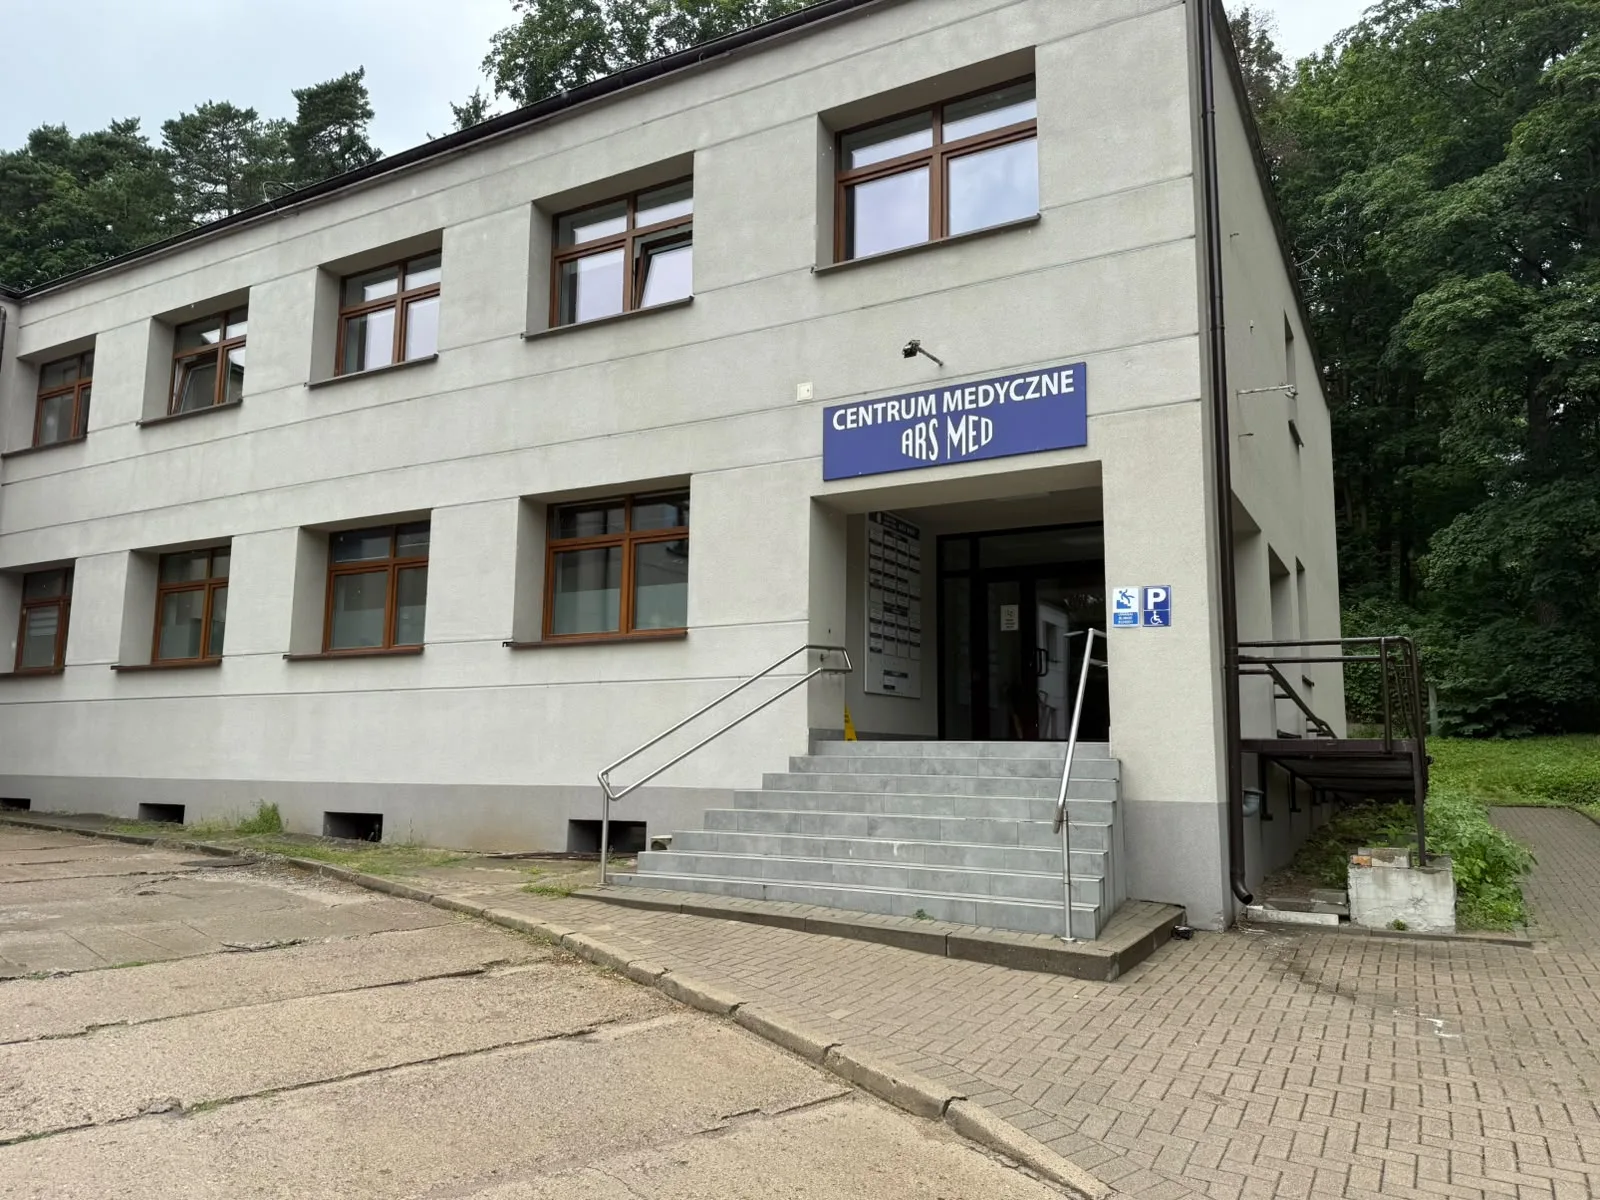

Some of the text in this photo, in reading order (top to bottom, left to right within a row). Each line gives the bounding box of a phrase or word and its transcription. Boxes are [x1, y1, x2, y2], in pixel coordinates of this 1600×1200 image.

[832, 369, 1075, 431] CENTRUM MEDYCZNE
[901, 415, 993, 461] ARS MED
[1147, 588, 1166, 609] P
